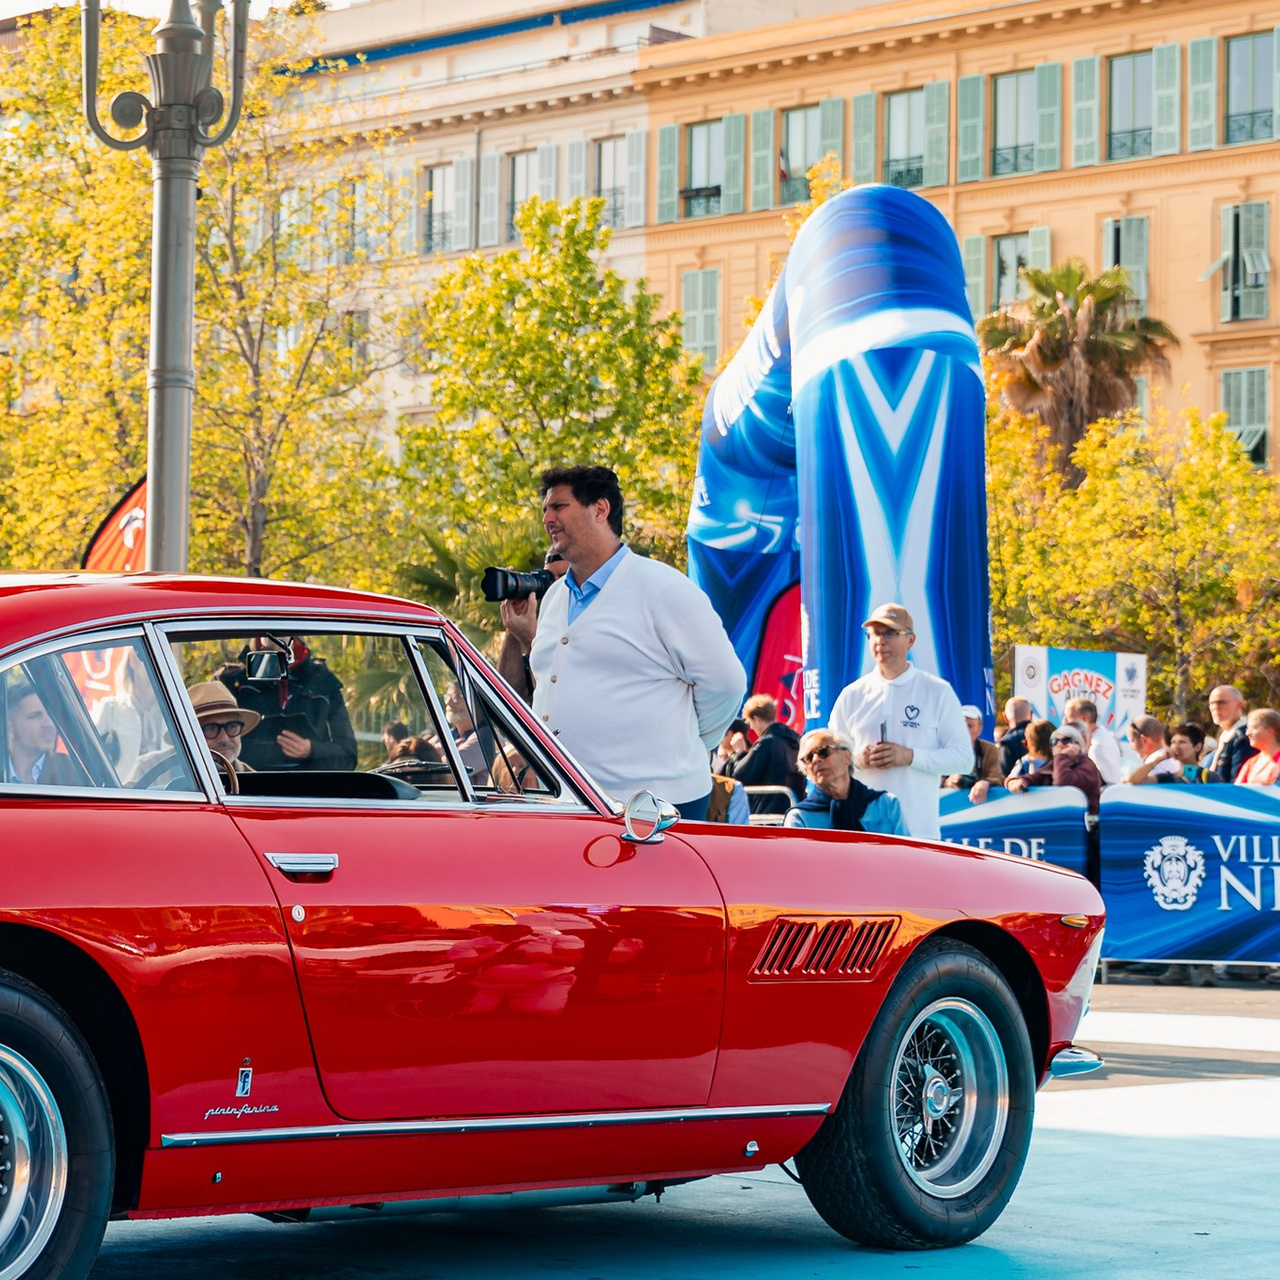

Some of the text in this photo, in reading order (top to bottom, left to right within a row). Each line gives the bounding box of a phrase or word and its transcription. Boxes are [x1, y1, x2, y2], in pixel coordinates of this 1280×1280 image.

[1049, 671, 1114, 700] GAGNEZ
[1002, 837, 1046, 863] DE
[204, 1103, 279, 1120] pininfarina
